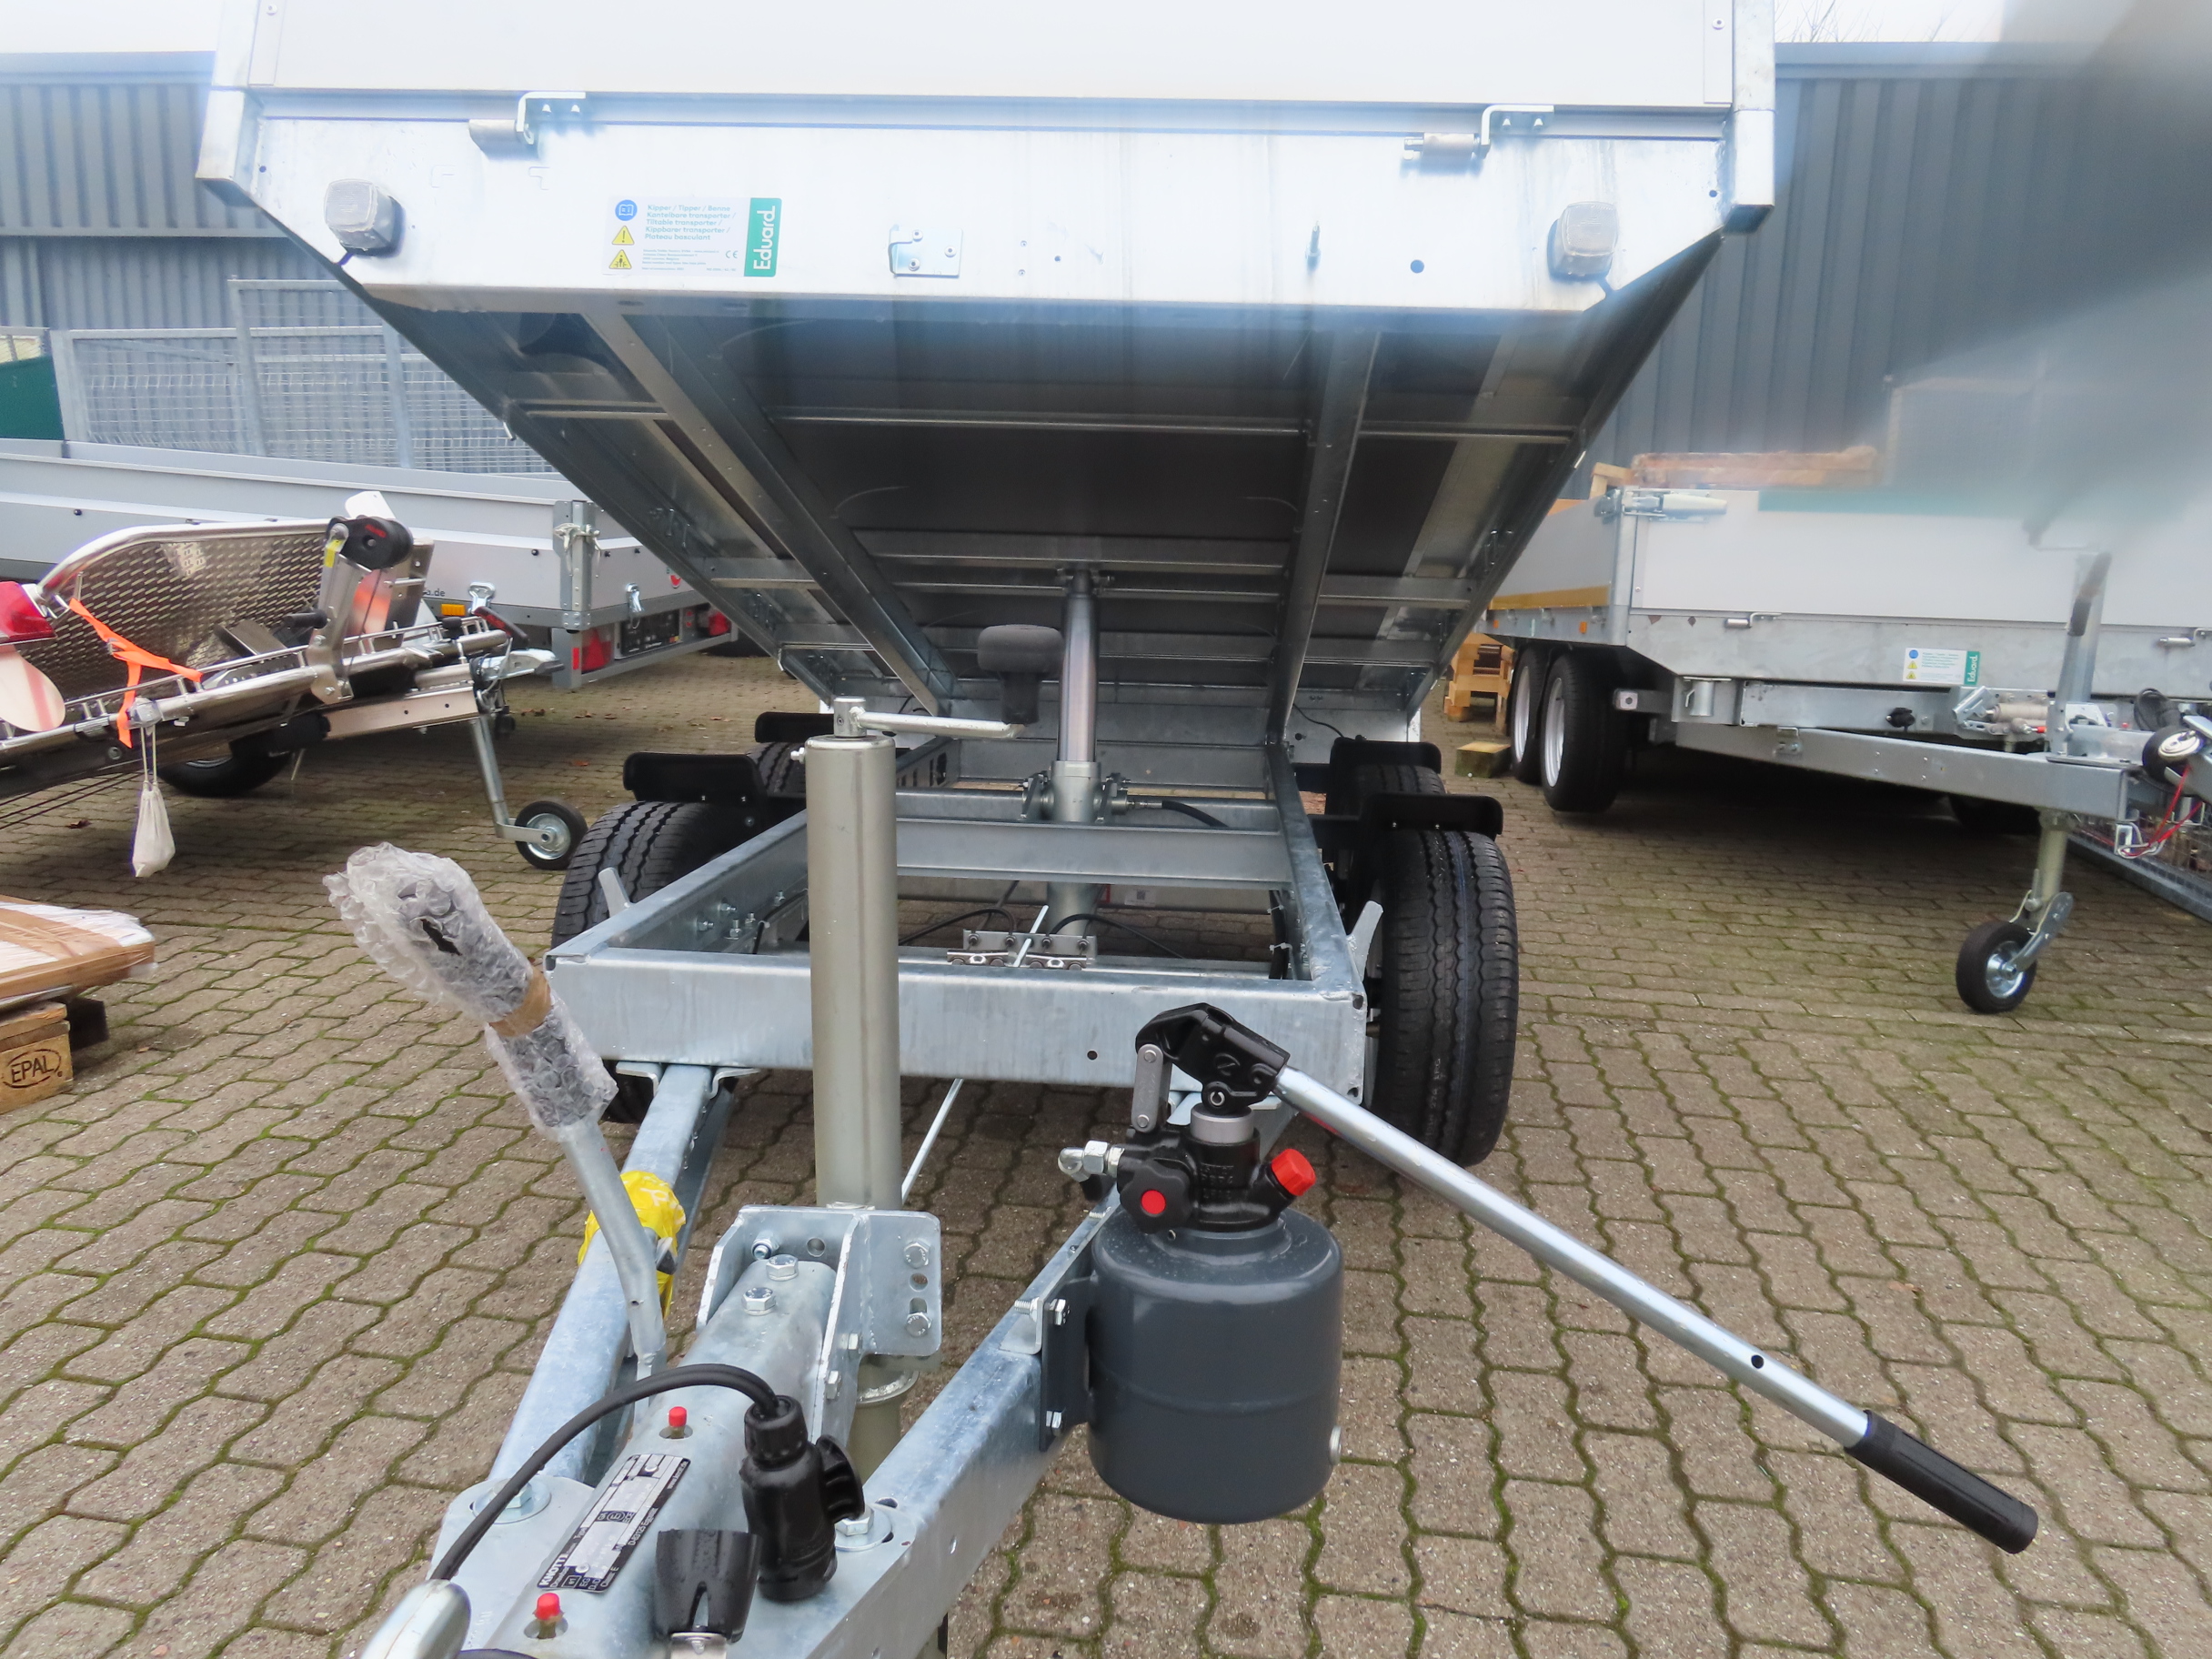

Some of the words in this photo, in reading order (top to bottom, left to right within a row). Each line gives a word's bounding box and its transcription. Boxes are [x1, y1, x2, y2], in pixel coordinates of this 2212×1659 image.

[689, 212, 731, 220] transporter
[675, 219, 717, 227] transporter
[683, 226, 726, 235] transporter
[725, 249, 739, 259] CE
[11, 1055, 55, 1083] EPAL
